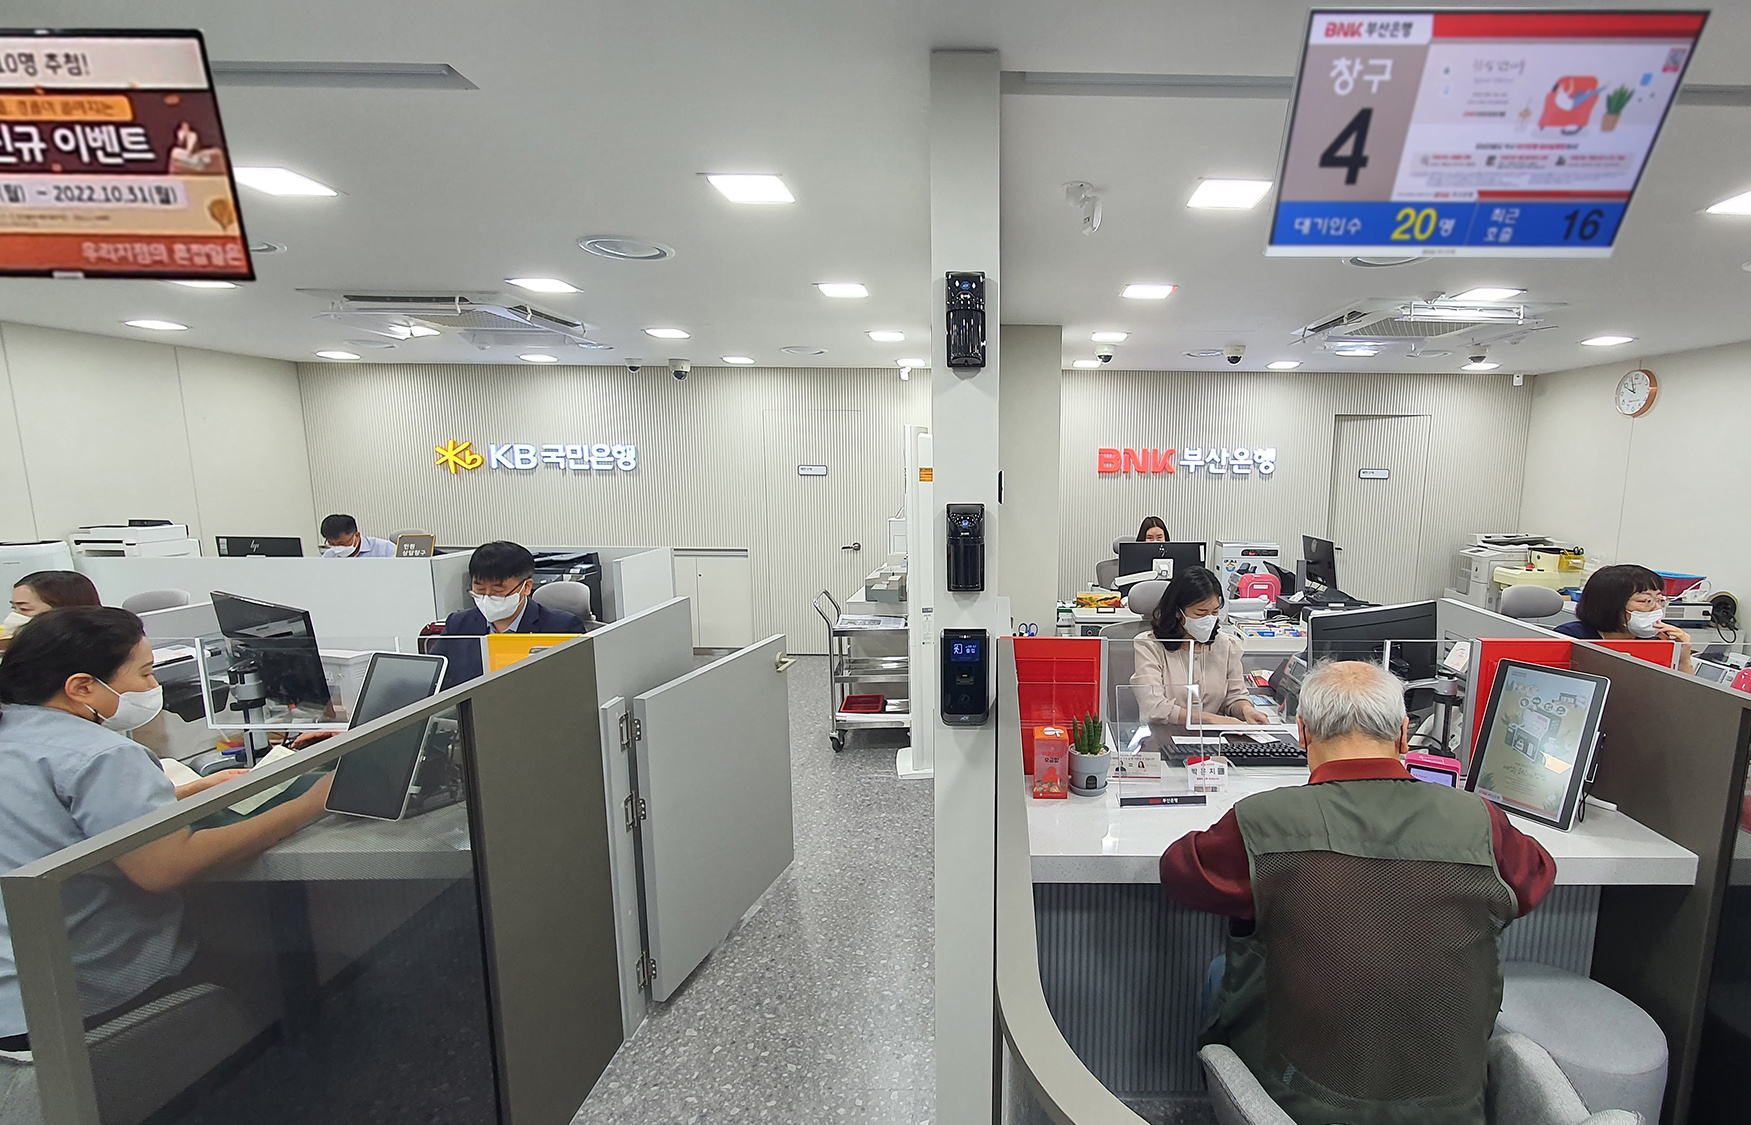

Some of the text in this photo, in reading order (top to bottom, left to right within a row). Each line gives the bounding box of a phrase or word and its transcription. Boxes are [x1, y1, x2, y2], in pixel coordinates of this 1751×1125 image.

[1324, 21, 1413, 38] BNK 부산은행
[1330, 57, 1393, 96] 창구
[53, 124, 156, 164] 이벤트
[1318, 107, 1374, 185] 4
[1294, 216, 1362, 236] 대기인수
[1563, 208, 1605, 241] 16
[489, 443, 538, 471] KB
[540, 443, 638, 472] 국민은행
[1097, 447, 1277, 475] BNK 부산은행
